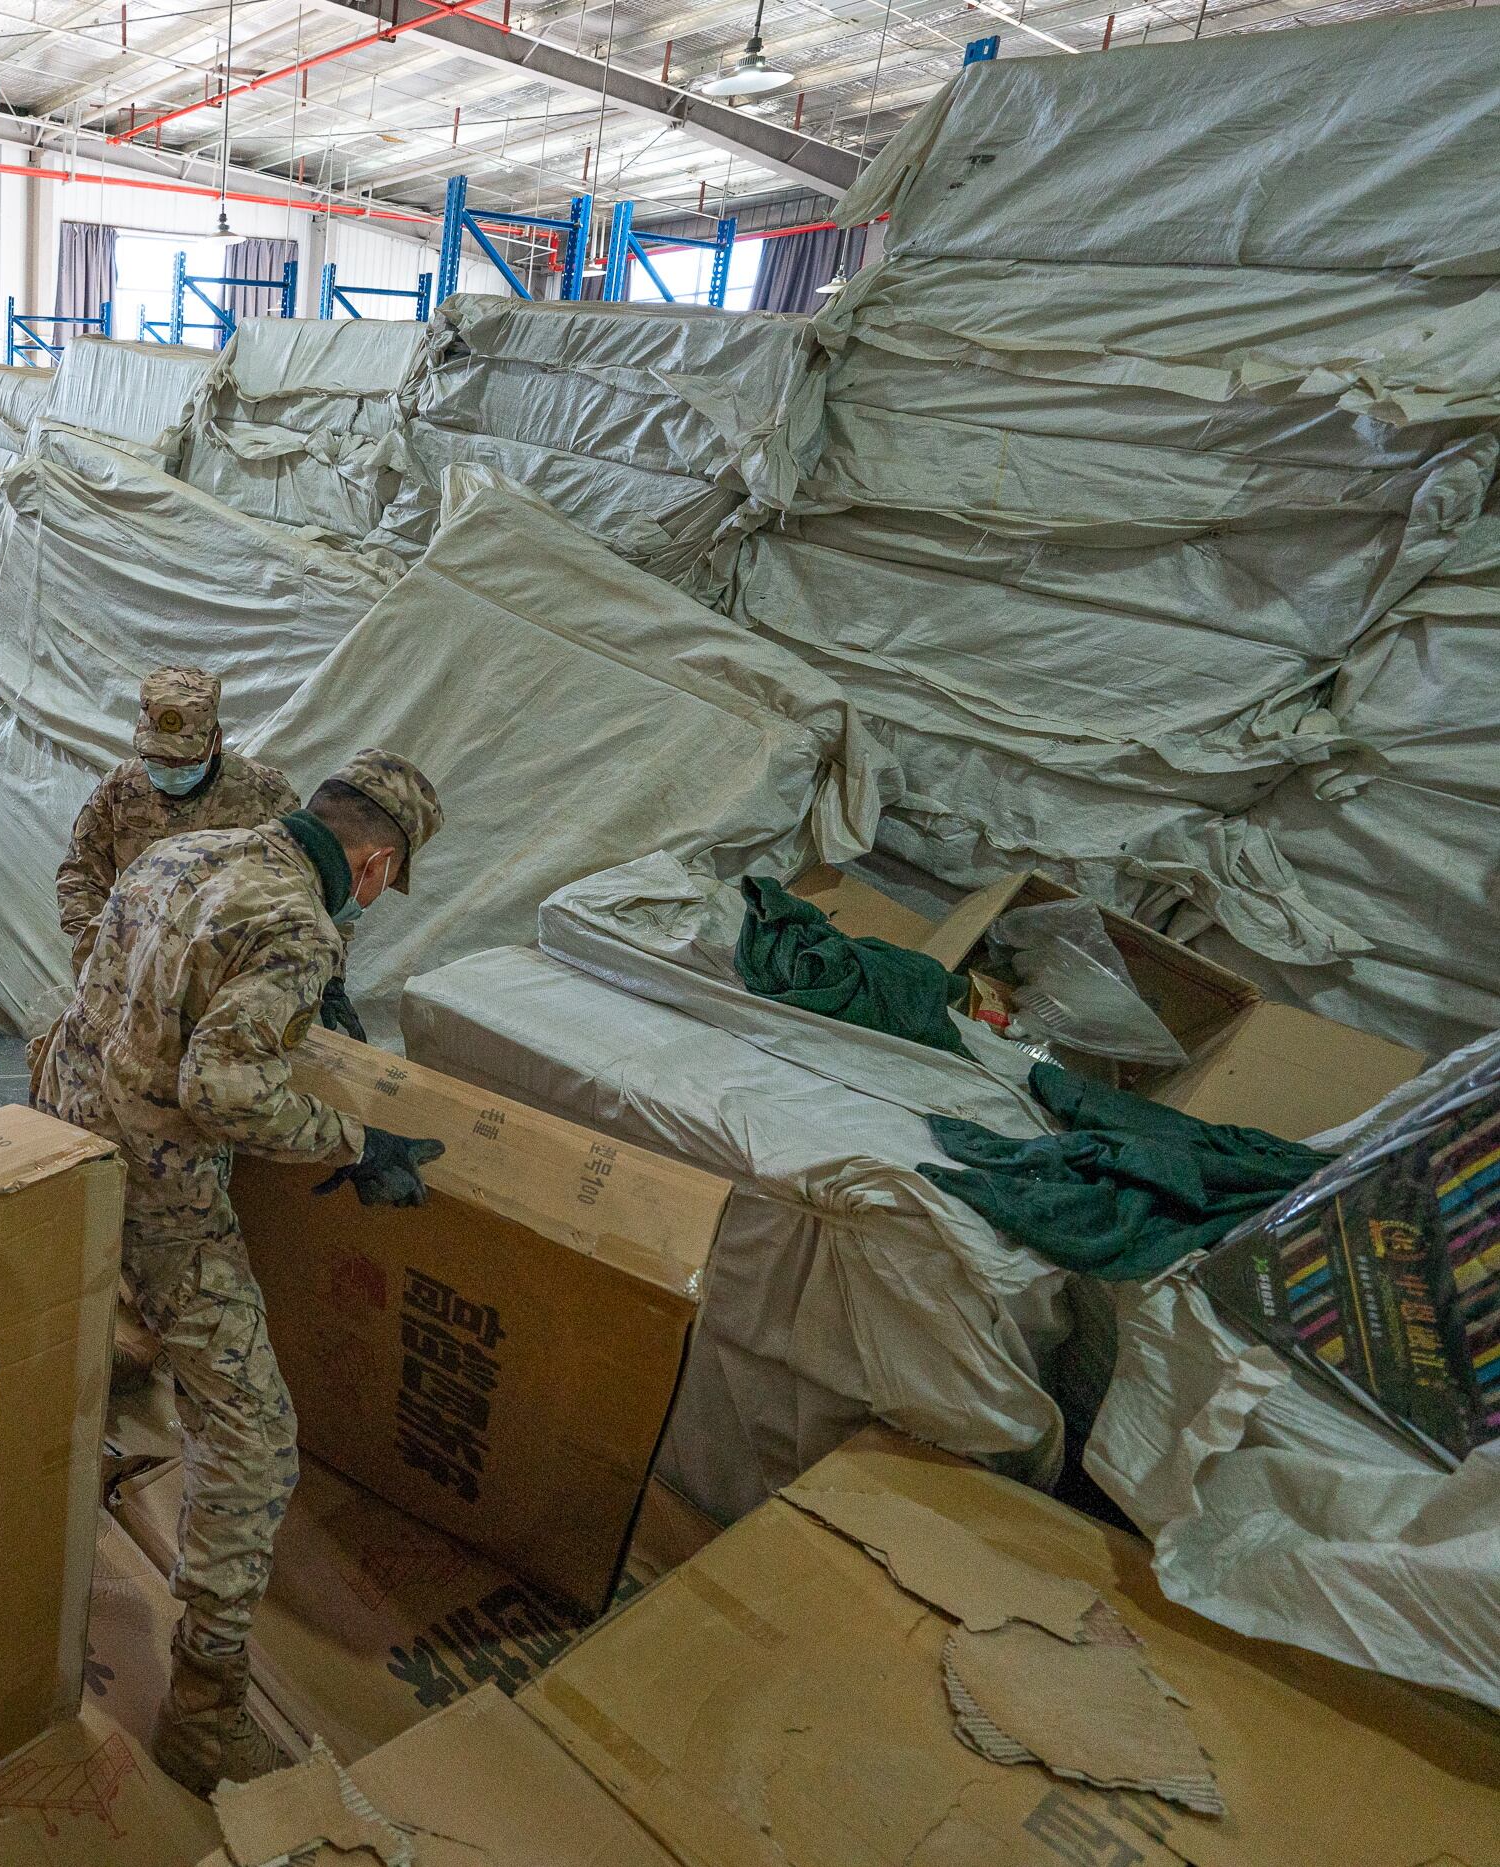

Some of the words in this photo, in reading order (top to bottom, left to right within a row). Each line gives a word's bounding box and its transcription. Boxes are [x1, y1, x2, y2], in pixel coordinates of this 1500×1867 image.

[396, 1265, 509, 1505] 高档四折床
